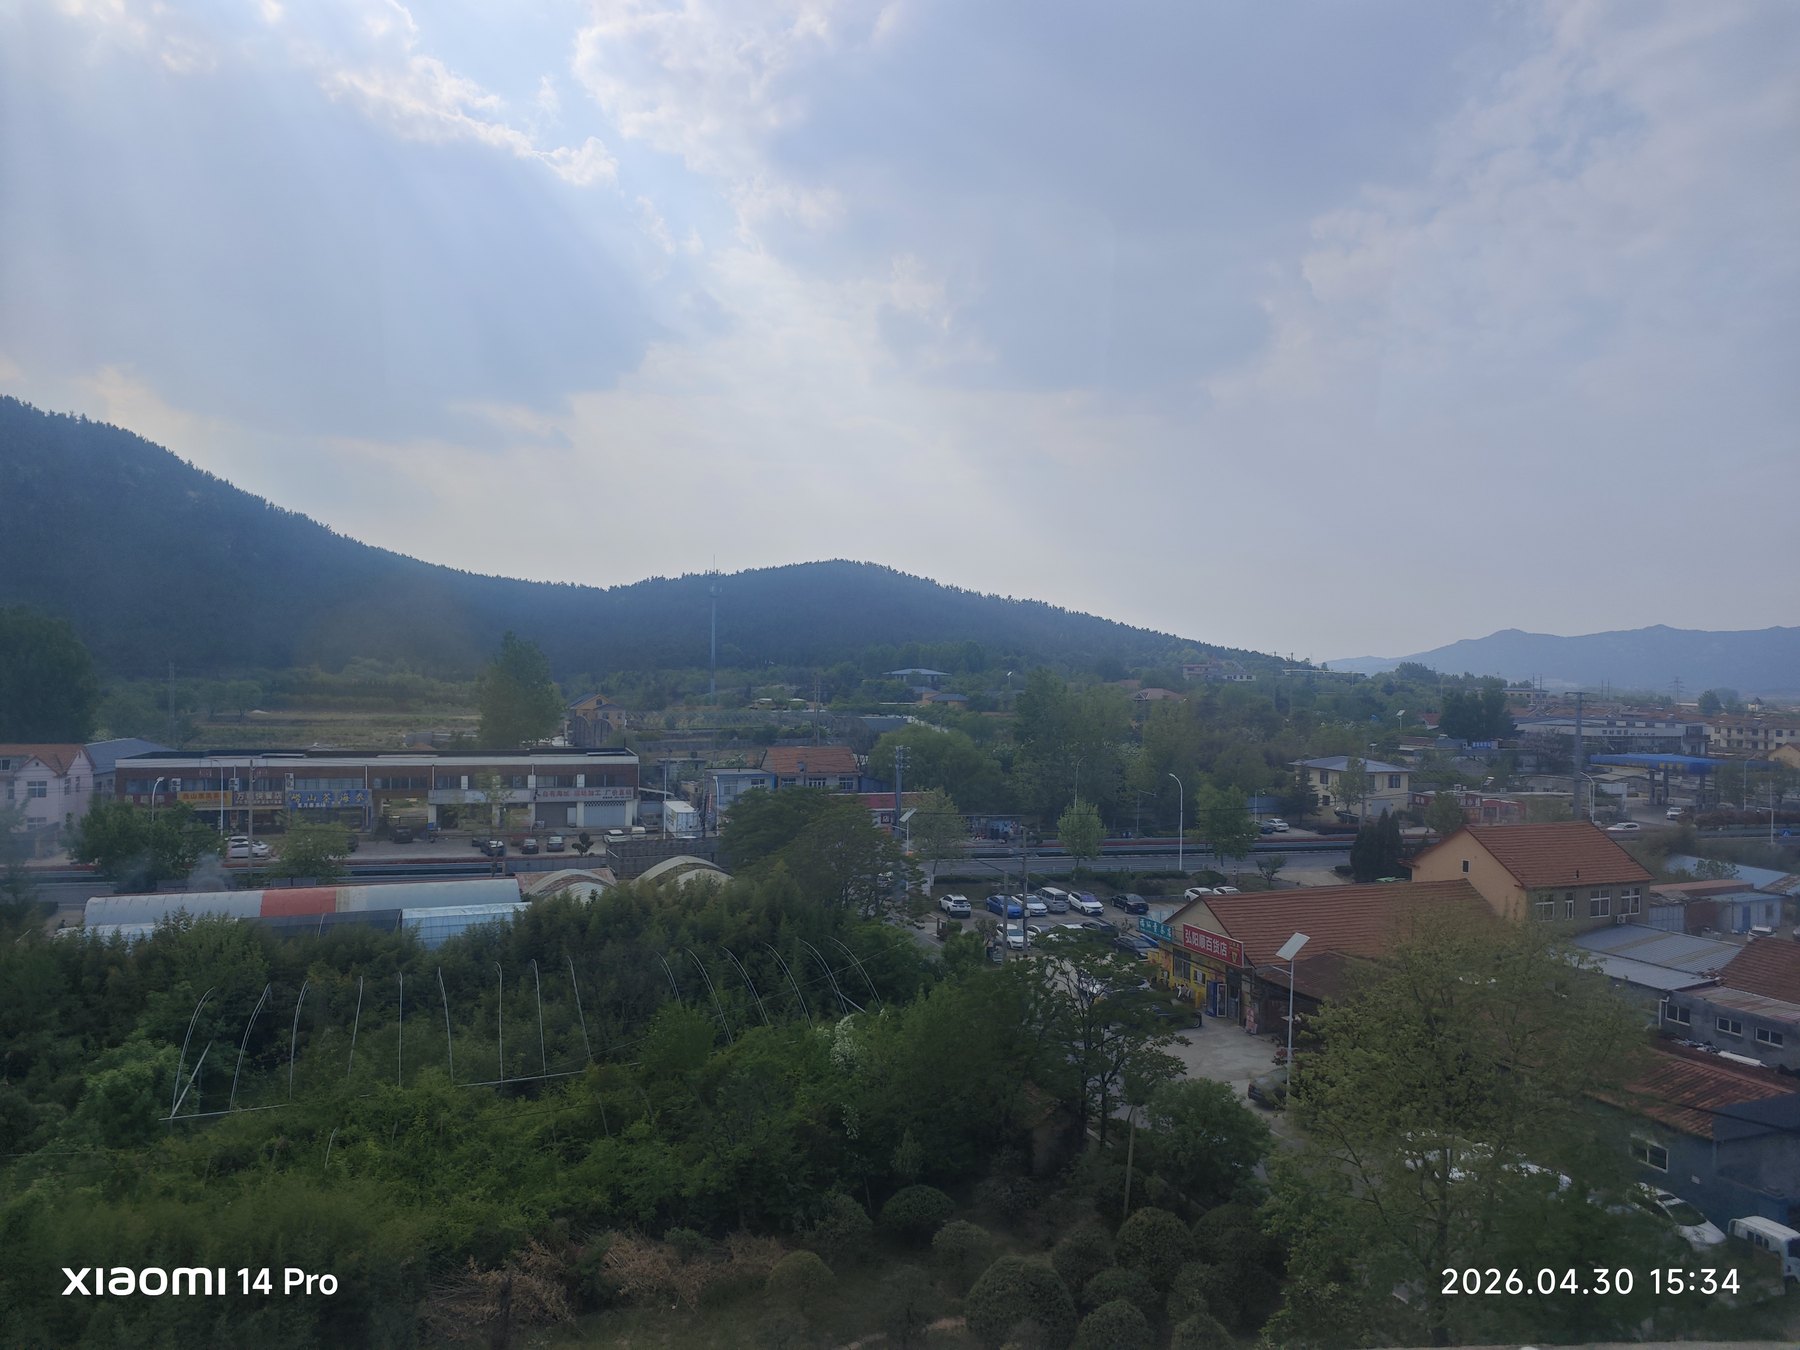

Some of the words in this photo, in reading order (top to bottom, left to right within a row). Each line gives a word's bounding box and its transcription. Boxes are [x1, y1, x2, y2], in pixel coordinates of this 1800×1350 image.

[1185, 929, 1227, 956] 弘阳顺百货店
